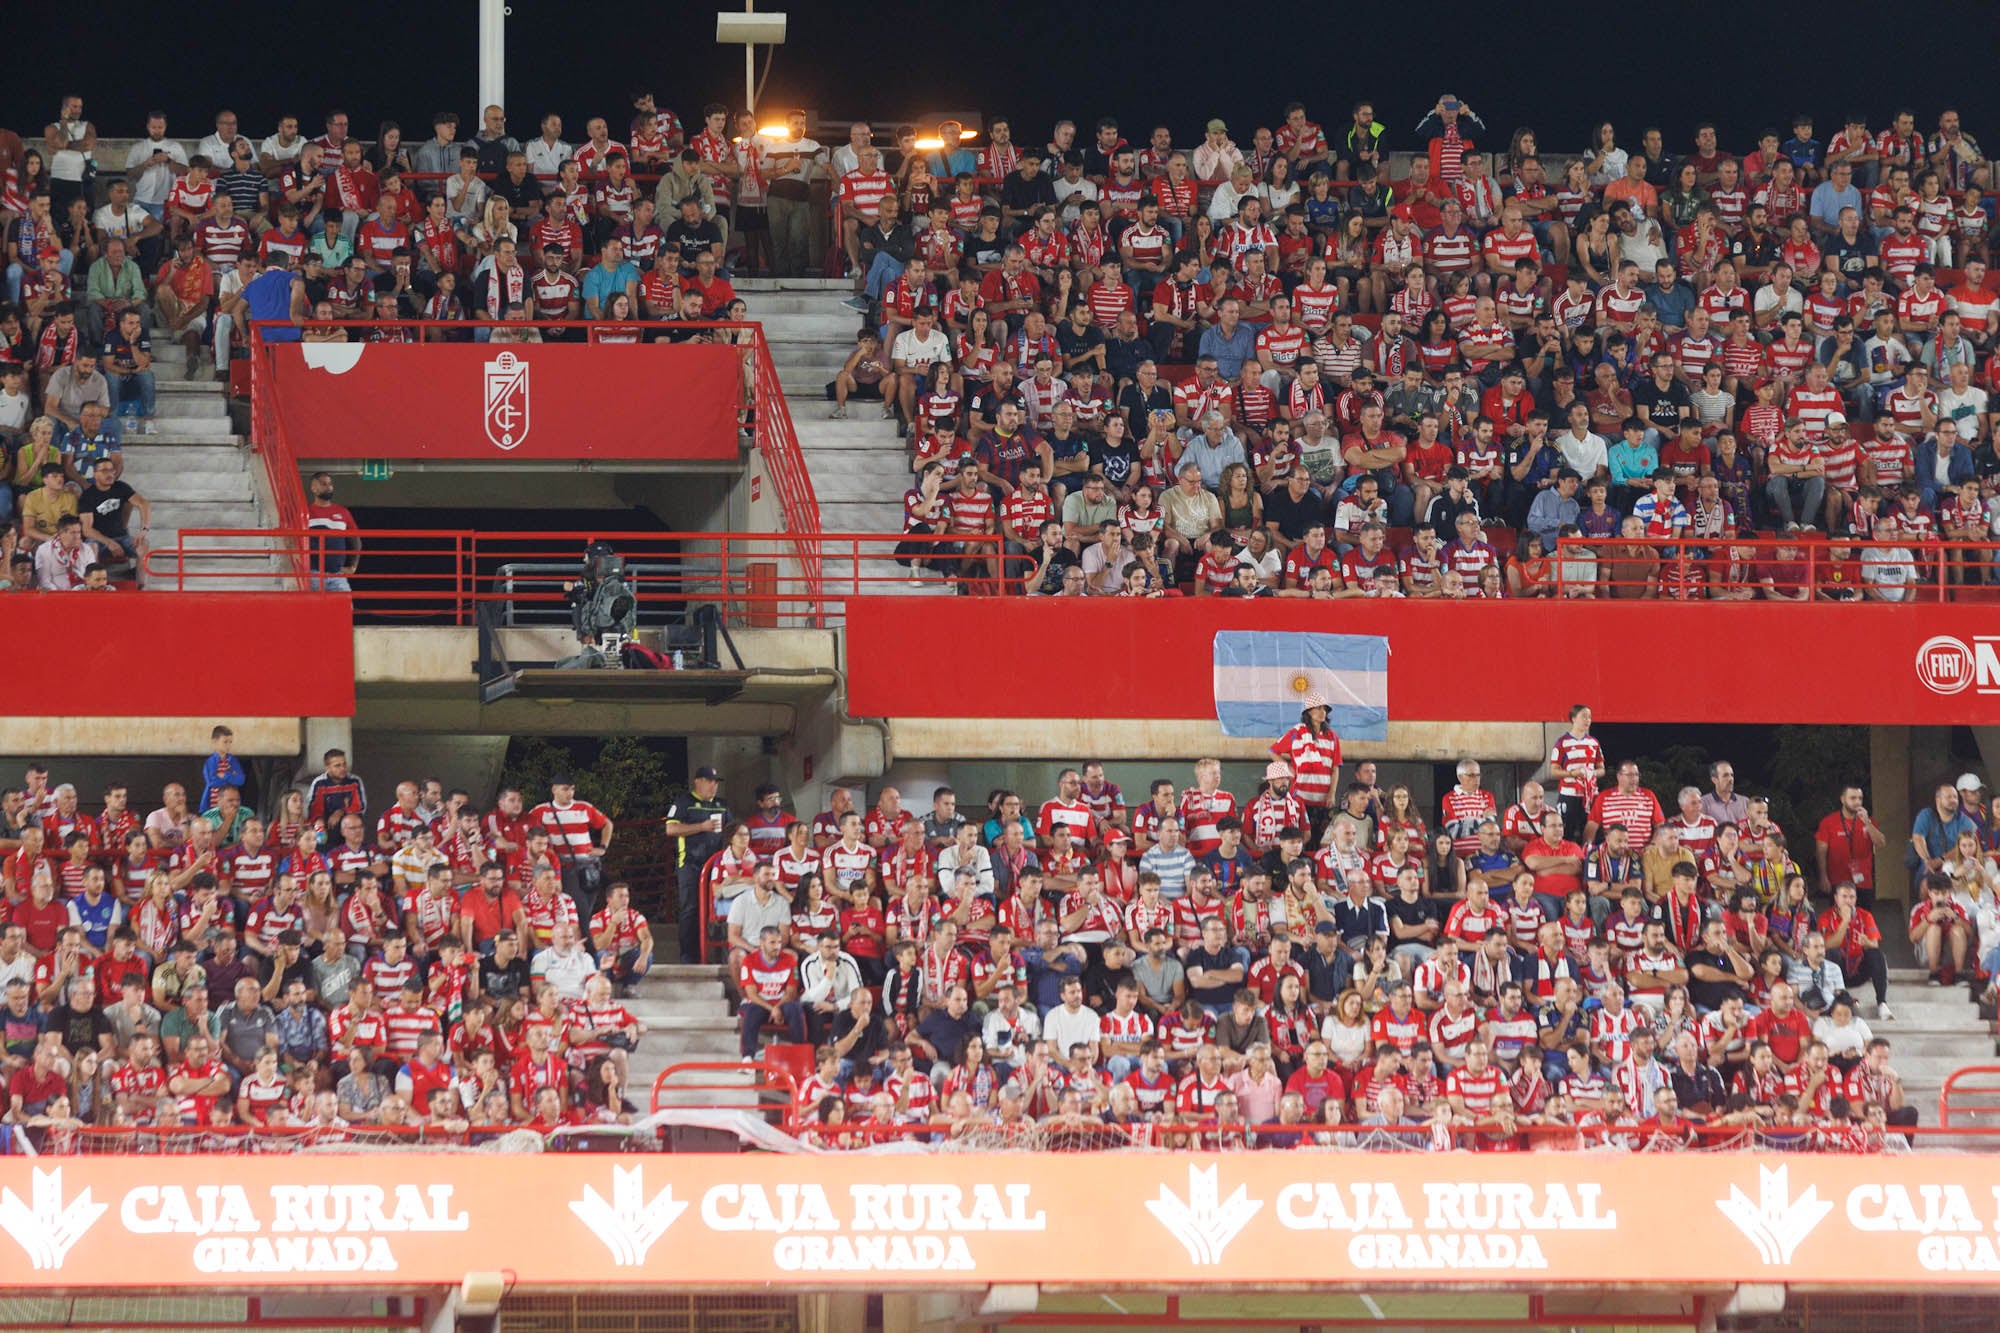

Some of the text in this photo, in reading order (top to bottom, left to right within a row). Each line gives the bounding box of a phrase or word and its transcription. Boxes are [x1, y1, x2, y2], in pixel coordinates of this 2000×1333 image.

[1930, 653, 1961, 678] FIAT
[121, 1184, 470, 1234] CAJA RURAL
[701, 1184, 1047, 1234] CAJA RURAL
[1276, 1183, 1617, 1232] CAJA RURAL
[1846, 1184, 1983, 1234] CAJA
[193, 1236, 398, 1272] GRANADA
[773, 1236, 977, 1271] GRANADA
[1348, 1234, 1549, 1270] GRANADA
